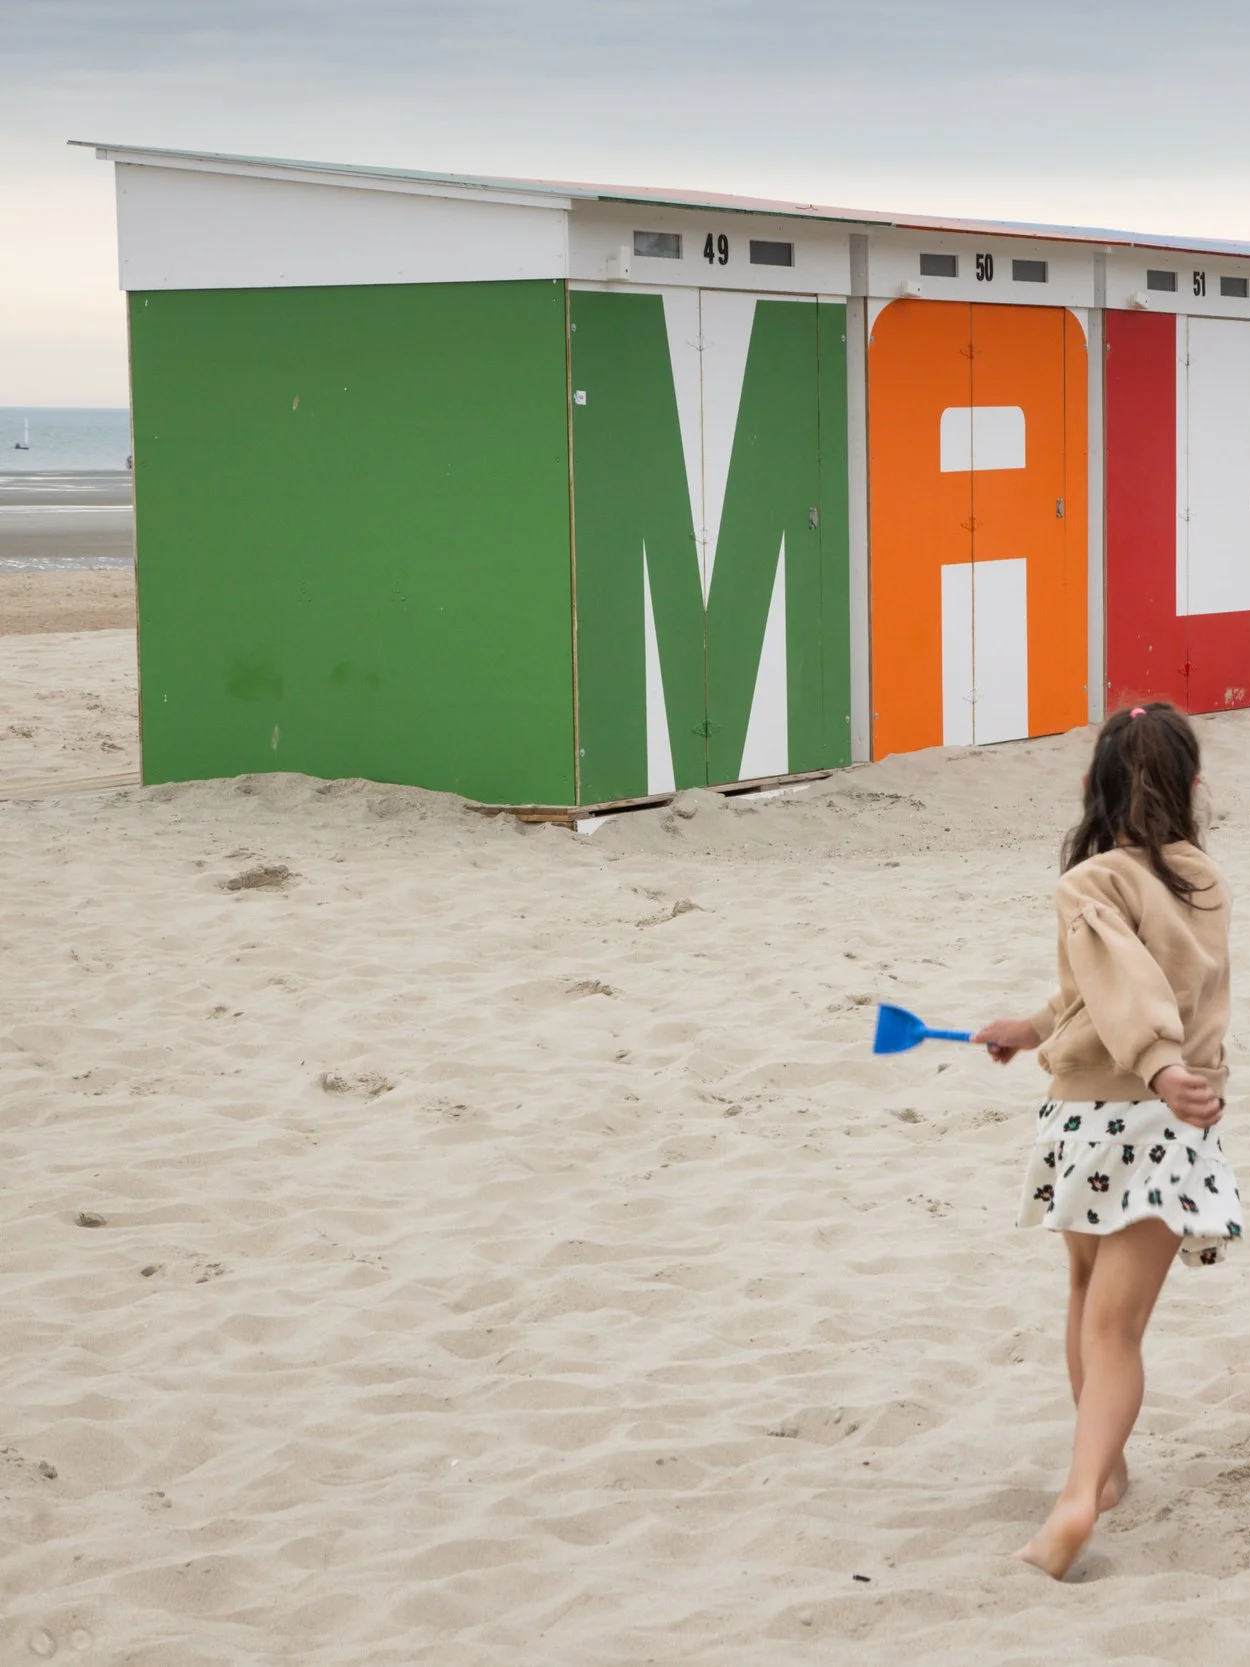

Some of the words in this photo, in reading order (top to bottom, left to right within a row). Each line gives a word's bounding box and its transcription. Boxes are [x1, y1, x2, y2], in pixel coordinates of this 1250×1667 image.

[703, 232, 729, 266] 49
[975, 252, 994, 283] 50
[1193, 270, 1207, 298] 51
